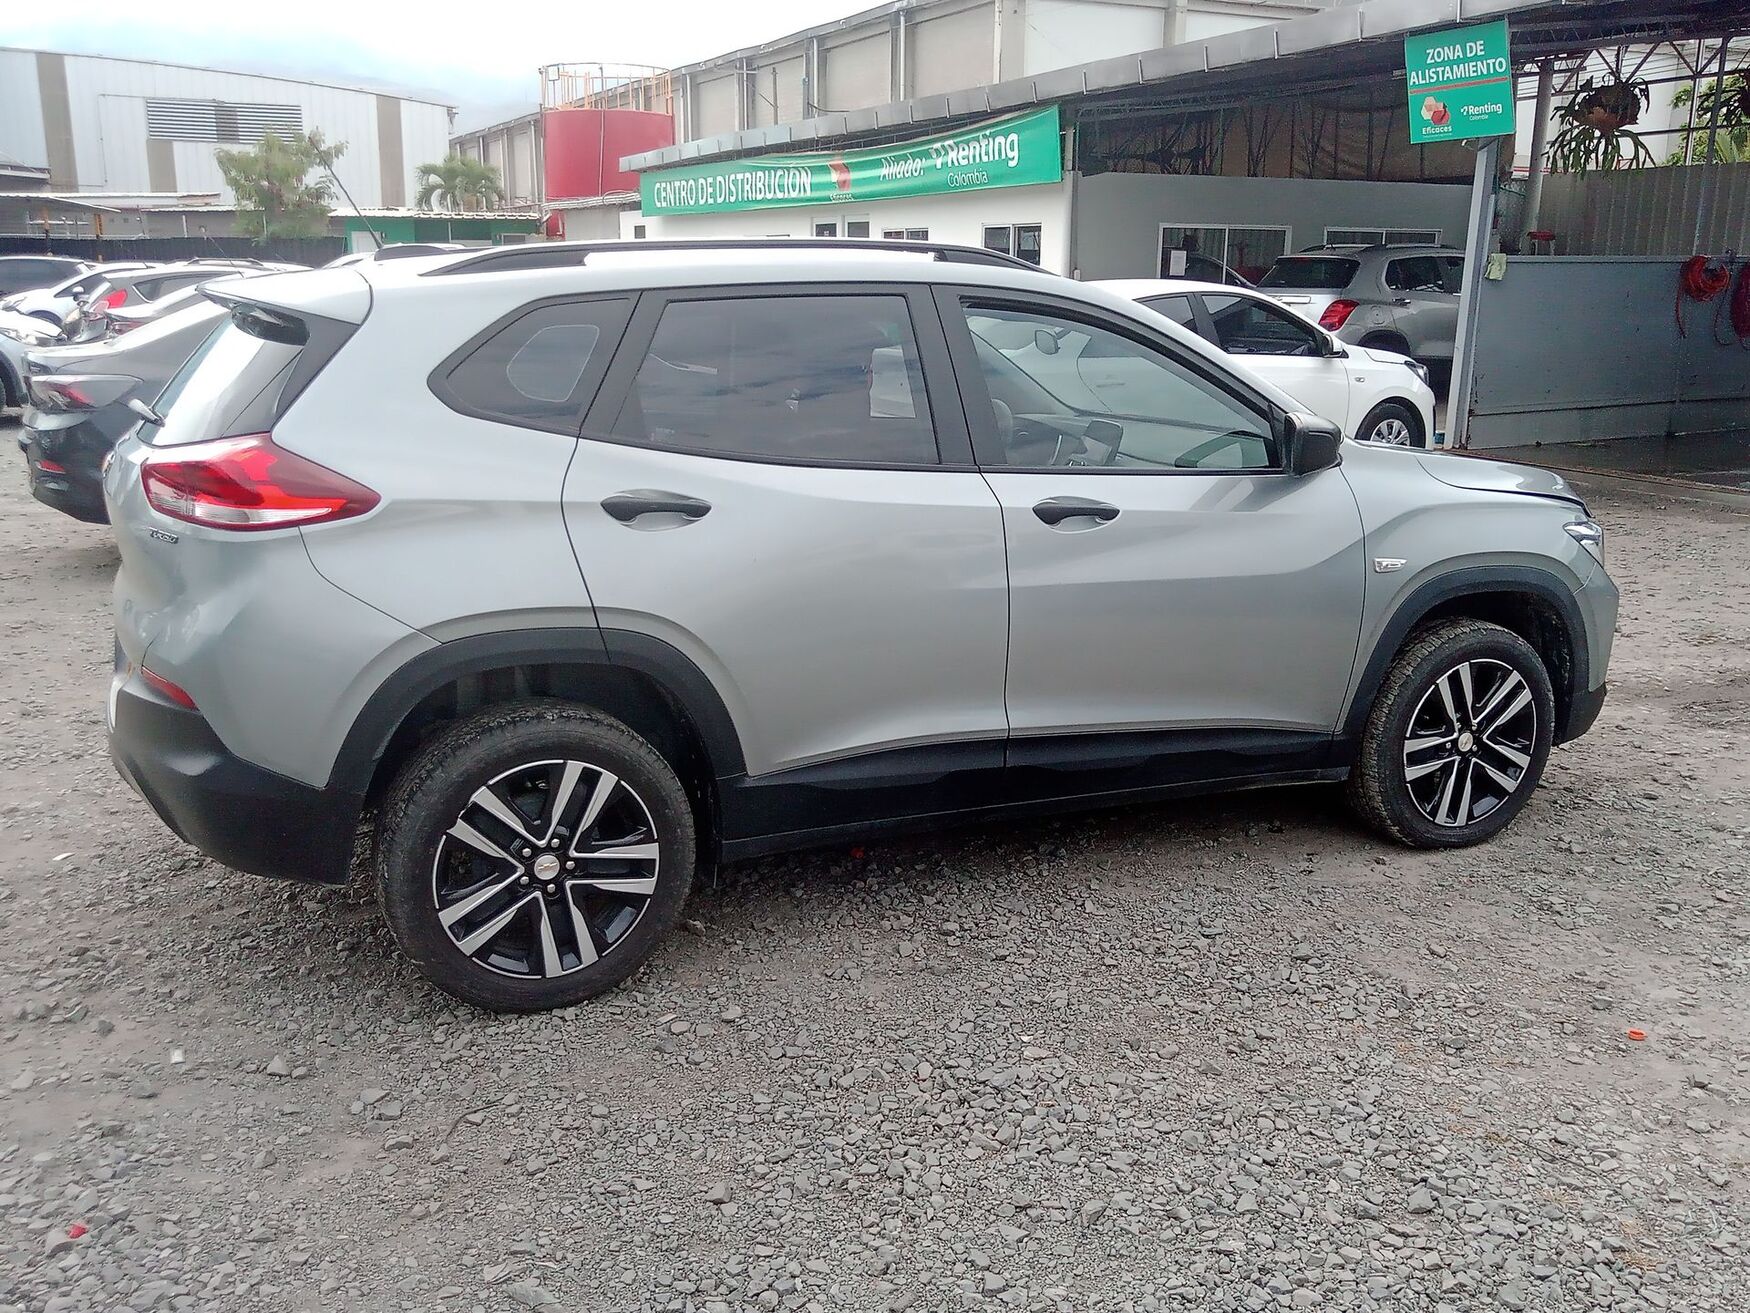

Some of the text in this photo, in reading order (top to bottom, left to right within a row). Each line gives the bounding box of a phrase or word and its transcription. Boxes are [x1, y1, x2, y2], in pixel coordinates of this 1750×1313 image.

[1426, 40, 1485, 64] ZONA DE
[1409, 57, 1507, 86] ALISTAMIENTO
[1469, 101, 1502, 115] Renting
[1422, 125, 1452, 135] Eficaces
[946, 130, 1019, 168] Renting
[947, 167, 989, 188] Colombia
[654, 180, 696, 208] CENTRO
[699, 176, 715, 206] DE
